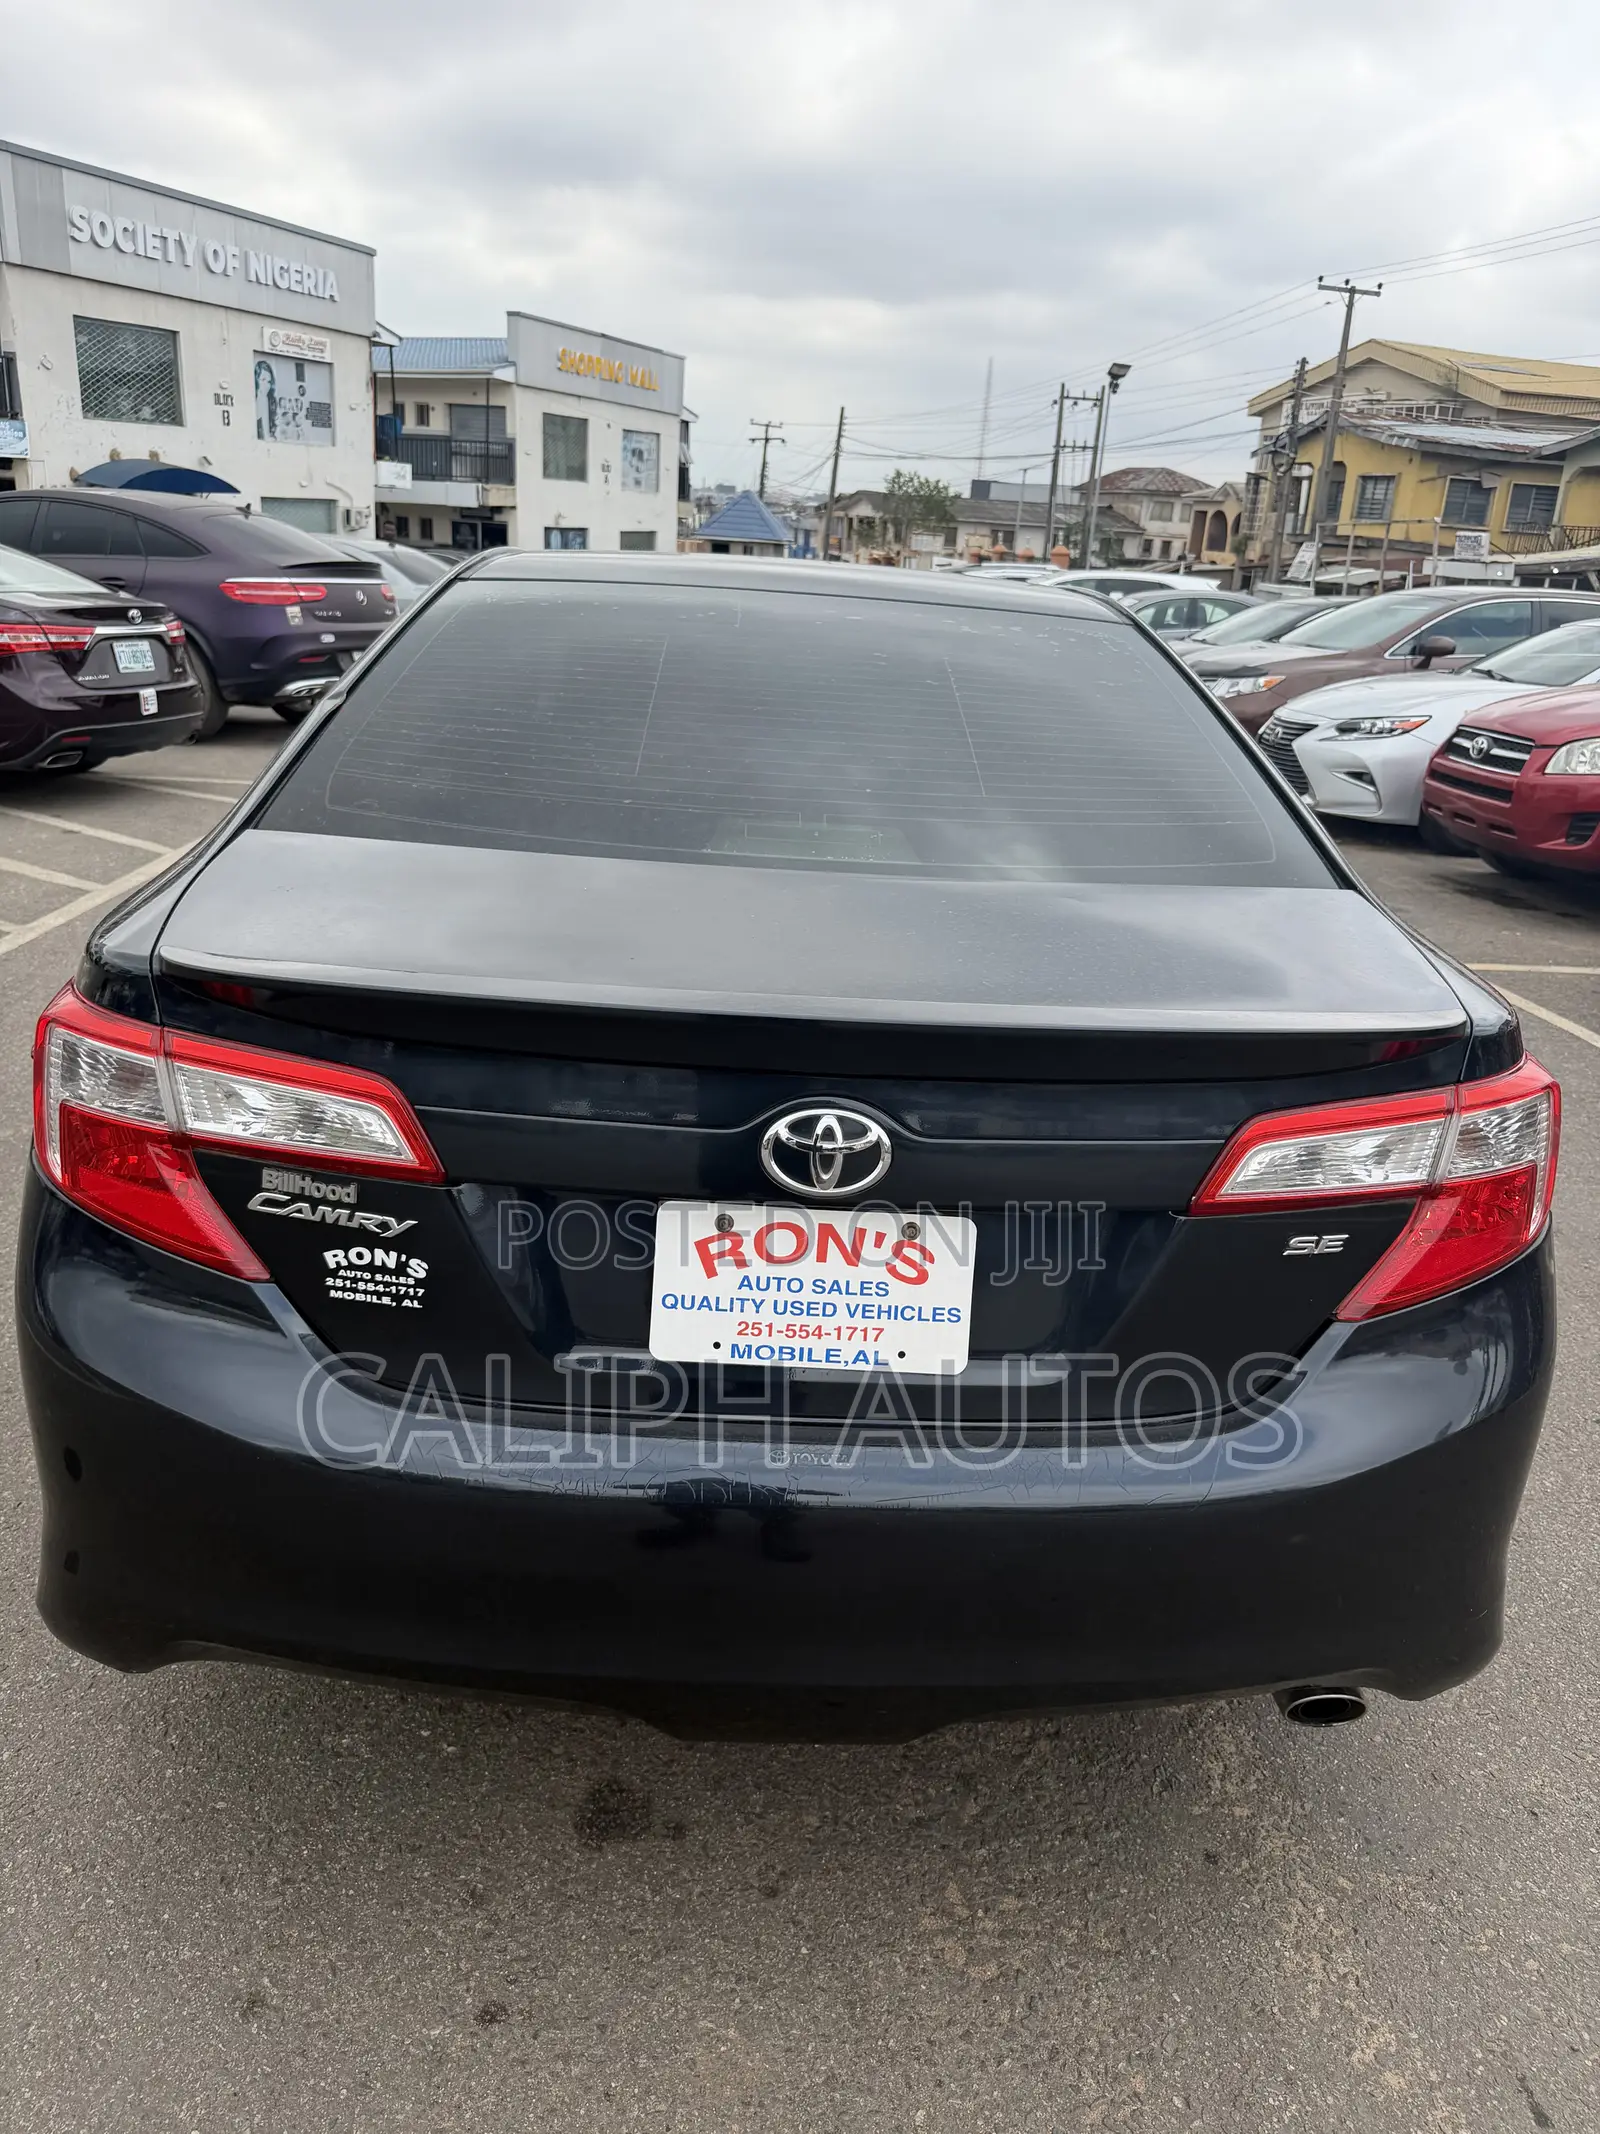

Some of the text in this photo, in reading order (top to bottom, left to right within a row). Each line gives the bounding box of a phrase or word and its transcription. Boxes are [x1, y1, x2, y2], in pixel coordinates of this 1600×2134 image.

[69, 205, 340, 302] SOCIETY OF NIGERIA
[557, 347, 660, 391] SHOPPING MALL
[222, 409, 231, 427] B
[262, 1167, 358, 1203] BillHood
[247, 1192, 418, 1238] CAMRY
[694, 1221, 936, 1286] RON'S
[1282, 1234, 1350, 1256] SE
[323, 1247, 429, 1279] RON'S
[325, 1278, 425, 1297] 251-554-1717
[337, 1269, 415, 1285] AUTO SALES
[737, 1275, 890, 1297] AUTO SALES
[329, 1289, 423, 1309] MOBILE, AL
[661, 1293, 962, 1323] QUALITY USED VEHICLES
[736, 1321, 885, 1343] 251-554-1717
